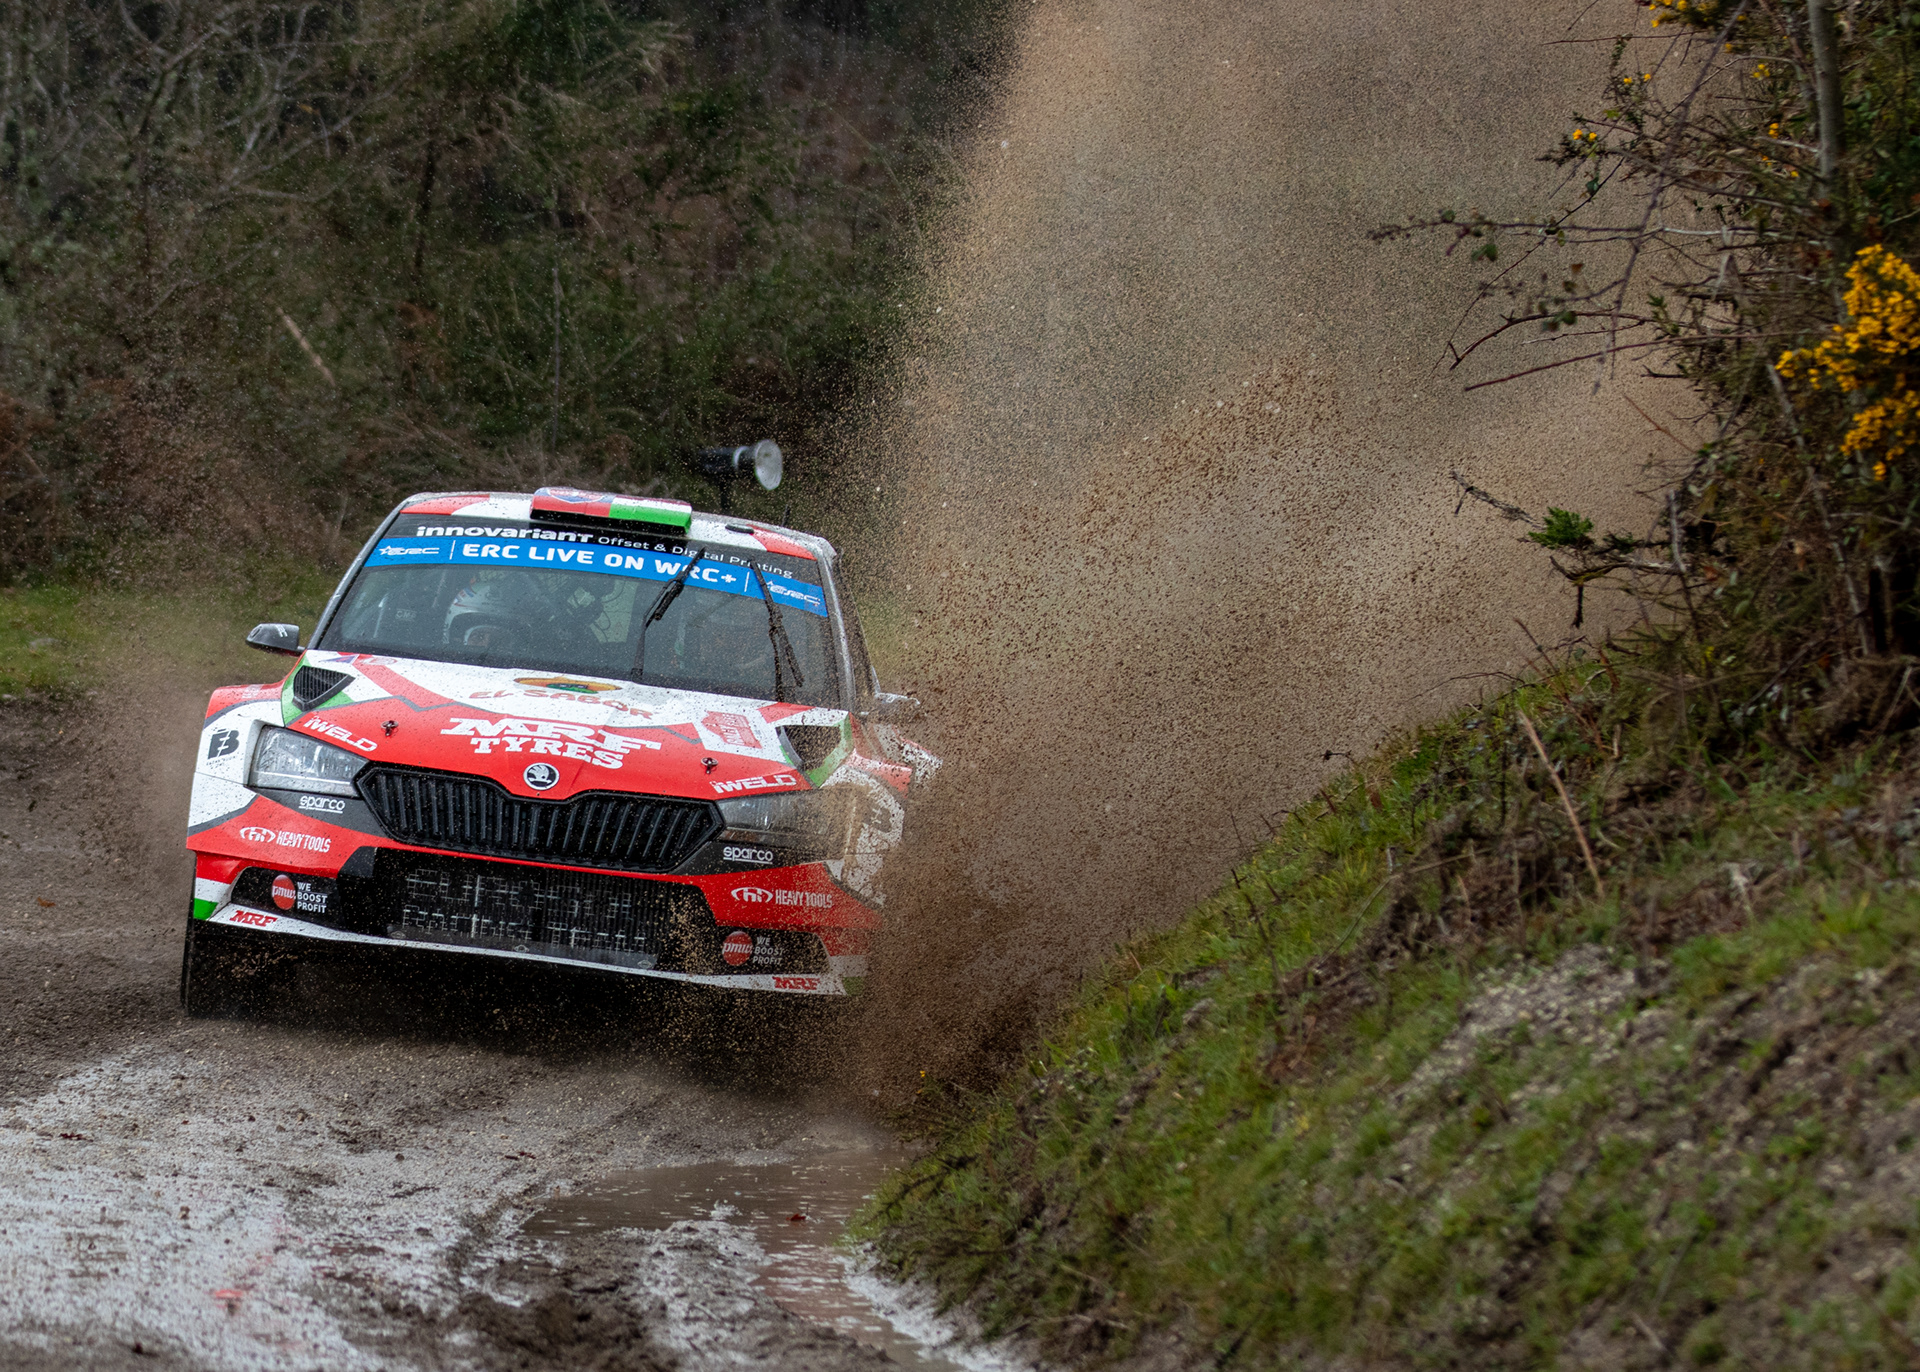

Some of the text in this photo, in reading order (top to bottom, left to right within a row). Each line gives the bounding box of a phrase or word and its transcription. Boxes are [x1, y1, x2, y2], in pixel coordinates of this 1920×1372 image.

[462, 544, 520, 559] ERC
[528, 546, 594, 564] LIVE
[603, 553, 645, 570] ON
[598, 536, 650, 550] Offset
[654, 543, 667, 552] &
[672, 546, 724, 562] Digtal
[524, 690, 653, 720] SABOR
[440, 718, 663, 754] MRF
[470, 736, 624, 769] TYRES
[300, 795, 345, 811] sparco
[276, 831, 304, 848] HEAVY
[303, 834, 331, 853] TOOLS
[723, 846, 773, 861] sparco
[297, 882, 311, 891] WE
[297, 892, 328, 903] BOOST
[775, 890, 804, 906] HEAVY
[805, 892, 833, 908] TOOLS
[297, 902, 327, 913] PROFIT
[230, 910, 278, 927] MRF
[757, 936, 771, 945] WE
[754, 946, 784, 956] BOOST
[753, 956, 783, 966] PROFIT
[772, 976, 820, 990] MRF
